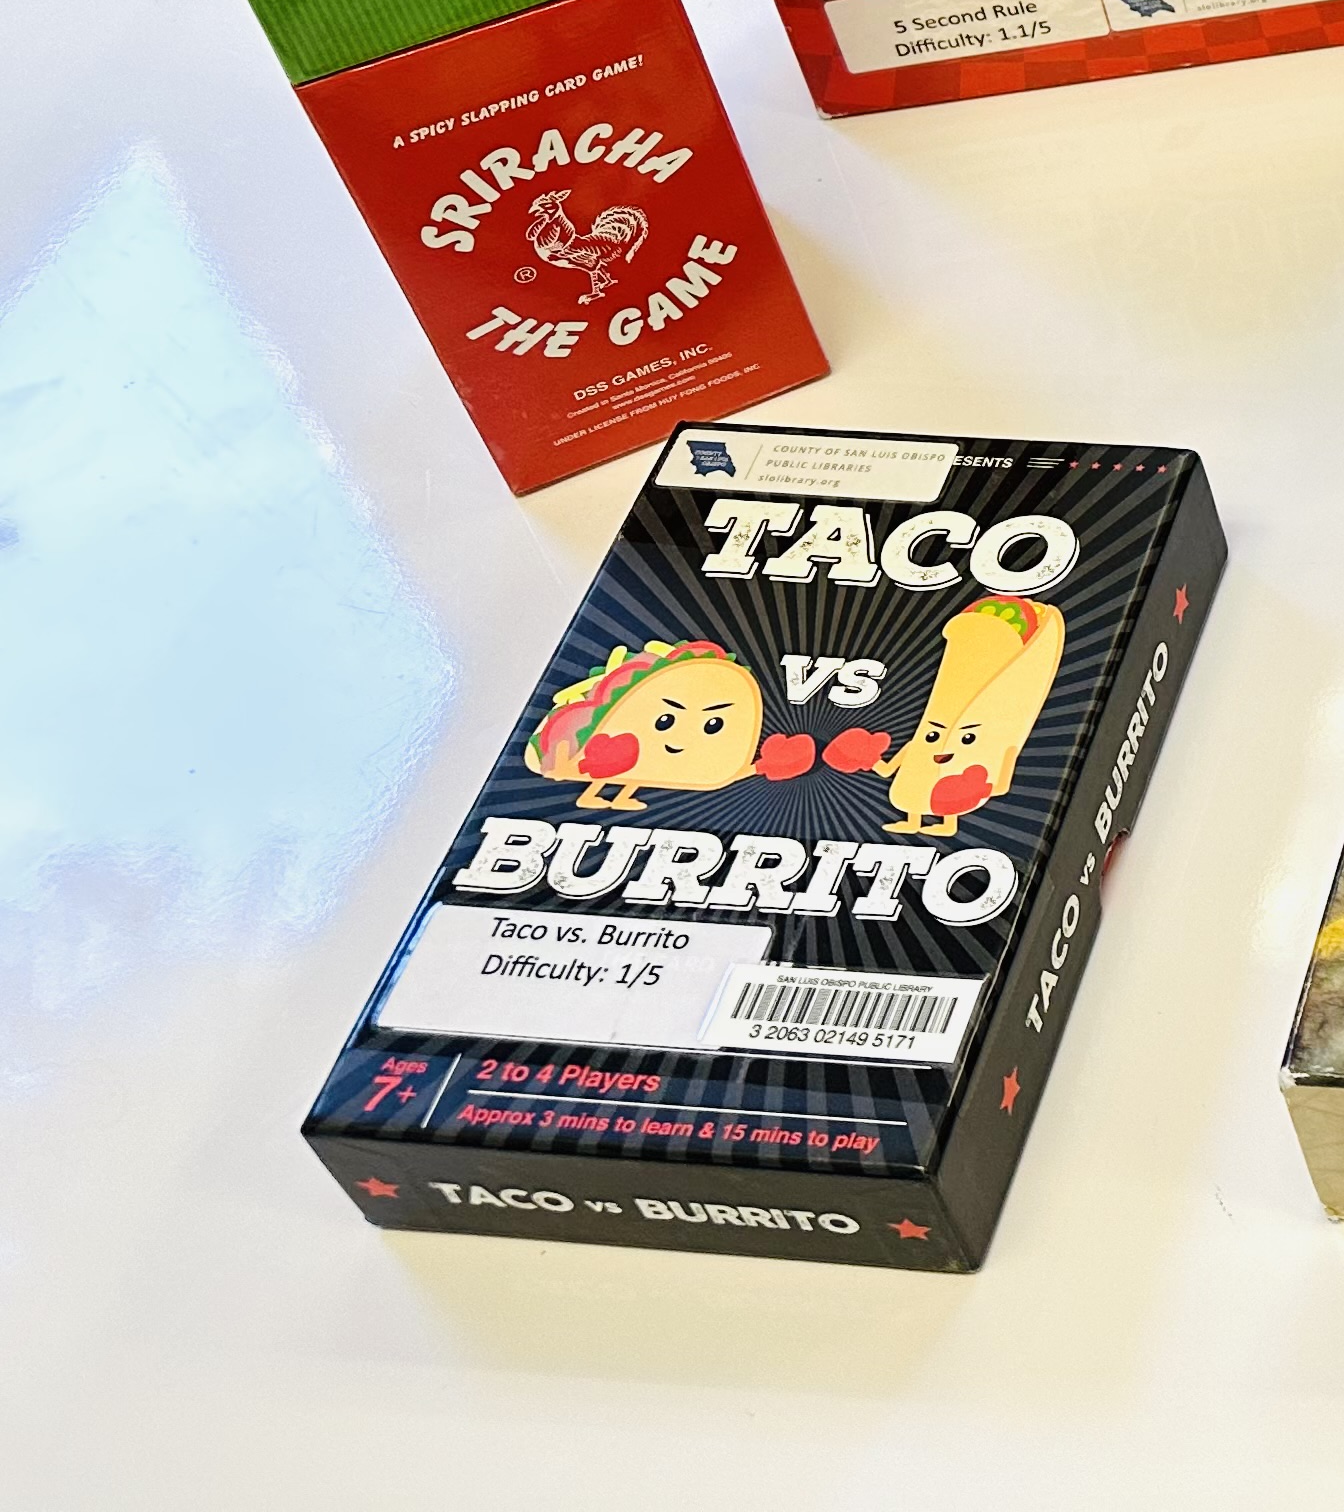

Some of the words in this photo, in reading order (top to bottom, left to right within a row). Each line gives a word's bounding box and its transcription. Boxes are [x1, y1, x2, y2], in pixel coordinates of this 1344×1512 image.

[894, 20, 907, 34] 5
[912, 7, 988, 32] Second
[992, 0, 1038, 20] Rule
[895, 30, 993, 58] Difficulty:
[998, 20, 1052, 45] 1.1/5
[393, 136, 405, 148] A
[409, 118, 455, 145] SPICY
[461, 91, 540, 126] SLAPPING
[544, 73, 588, 98] CARD
[592, 55, 645, 82] GAME!
[420, 122, 693, 253] SRIRACHA
[466, 306, 588, 358] THE
[609, 234, 738, 346] GAME
[573, 381, 609, 401] DSS
[611, 357, 678, 387] GAMES,
[679, 343, 713, 362] INC.
[766, 458, 808, 469] PUBLIC
[812, 461, 873, 473] LIBRARIES
[773, 444, 820, 455] COUNTY
[825, 447, 839, 456] OF
[843, 448, 867, 458] SAN
[872, 450, 897, 460] LUIS
[902, 452, 945, 462] OBISPO
[758, 473, 840, 488] slolibrary.org
[702, 498, 1080, 596] TACO
[780, 654, 887, 709] VS
[1025, 893, 1081, 1033] TACO
[1095, 641, 1169, 845] BURRITO
[453, 817, 1018, 925] BURRITO
[491, 917, 547, 940] Taco
[557, 926, 587, 943] vs.
[597, 924, 690, 950] Burrito
[481, 954, 609, 986] Difficulty:
[616, 963, 664, 989] 1/5
[749, 1024, 762, 1038] 3
[765, 1026, 811, 1042] 2063
[814, 1029, 869, 1047] 02149
[872, 1033, 916, 1049] 5171
[381, 1056, 428, 1075] Ages
[477, 1059, 497, 1080] 2
[502, 1062, 529, 1082] to
[536, 1064, 555, 1083] 4
[559, 1064, 661, 1094] Players
[364, 1075, 417, 1112] 7+
[457, 1104, 536, 1128] Approx
[539, 1110, 555, 1127] 3
[557, 1112, 609, 1131] mins
[614, 1117, 635, 1133] to
[641, 1118, 694, 1137] learn
[699, 1122, 714, 1138] &
[723, 1123, 748, 1141] 15
[750, 1127, 802, 1145] mins
[808, 1131, 827, 1147] to
[832, 1133, 880, 1155] play
[428, 1181, 574, 1212] TACO
[634, 1197, 860, 1235] BURRITO
